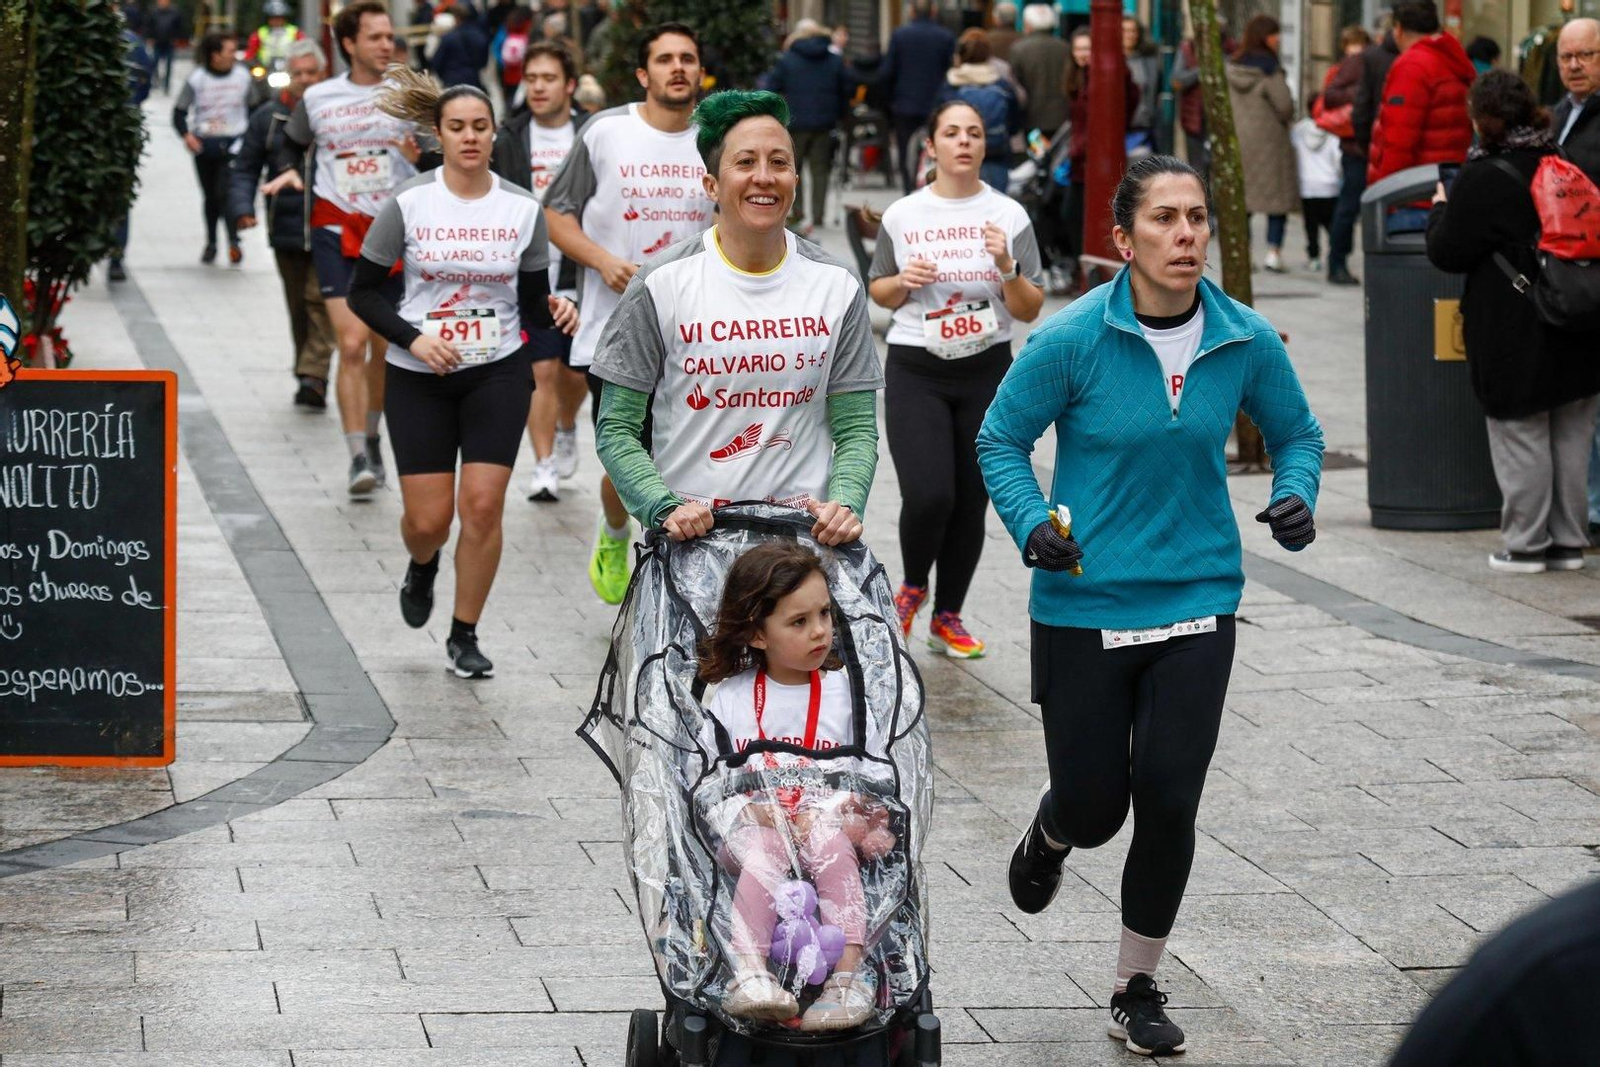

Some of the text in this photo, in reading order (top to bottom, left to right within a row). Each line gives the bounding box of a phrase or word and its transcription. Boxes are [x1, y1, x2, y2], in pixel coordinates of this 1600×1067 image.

[347, 158, 378, 175] 605
[619, 164, 706, 179] VI CARREIR
[621, 187, 684, 199] CALVARIO
[416, 227, 519, 242] VI CARREIRA
[904, 226, 985, 245] VI CARREI
[414, 250, 485, 263] CALVARIO
[436, 271, 512, 285] Santande
[935, 269, 999, 283] antande
[439, 320, 481, 342] 691
[679, 316, 831, 343] VI CARREIRA
[941, 315, 982, 339] 686
[684, 353, 786, 375] CALVARIO
[7, 403, 136, 459] URRERÍA
[0, 529, 150, 571] os y Domingos
[121, 575, 168, 609] de
